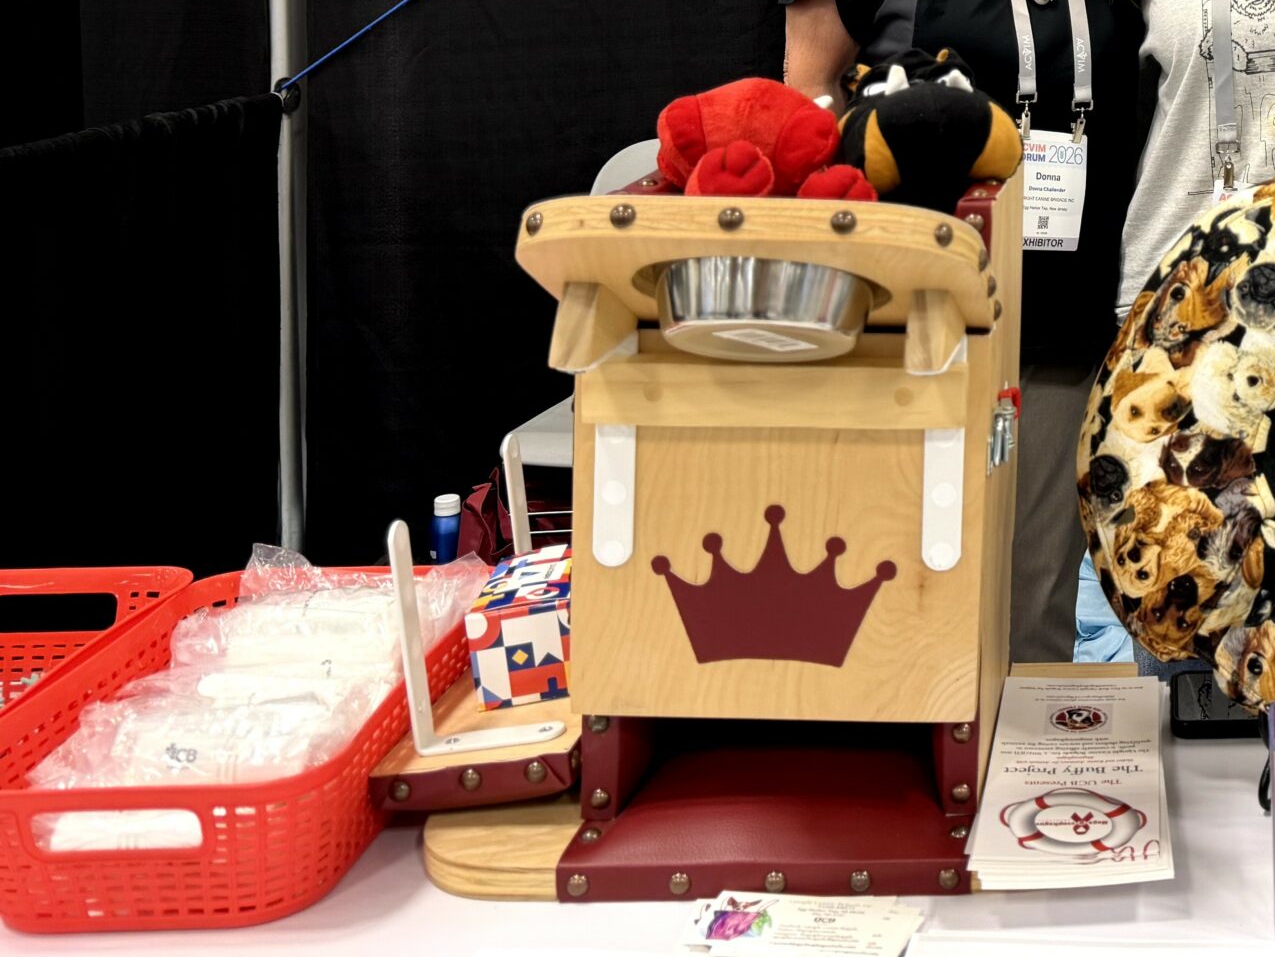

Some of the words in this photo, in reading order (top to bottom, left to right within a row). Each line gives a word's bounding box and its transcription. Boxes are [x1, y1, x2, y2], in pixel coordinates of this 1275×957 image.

[1024, 34, 1033, 71] ACVIM
[1076, 37, 1085, 73] ACVIM
[1024, 143, 1046, 153] CVIM
[1048, 145, 1083, 165] 2026
[1036, 172, 1061, 182] Donna
[1023, 238, 1064, 248] XHIBITOR
[1003, 765, 1057, 776] Project
[1062, 765, 1107, 777] Buffy
[1113, 765, 1144, 774] The
